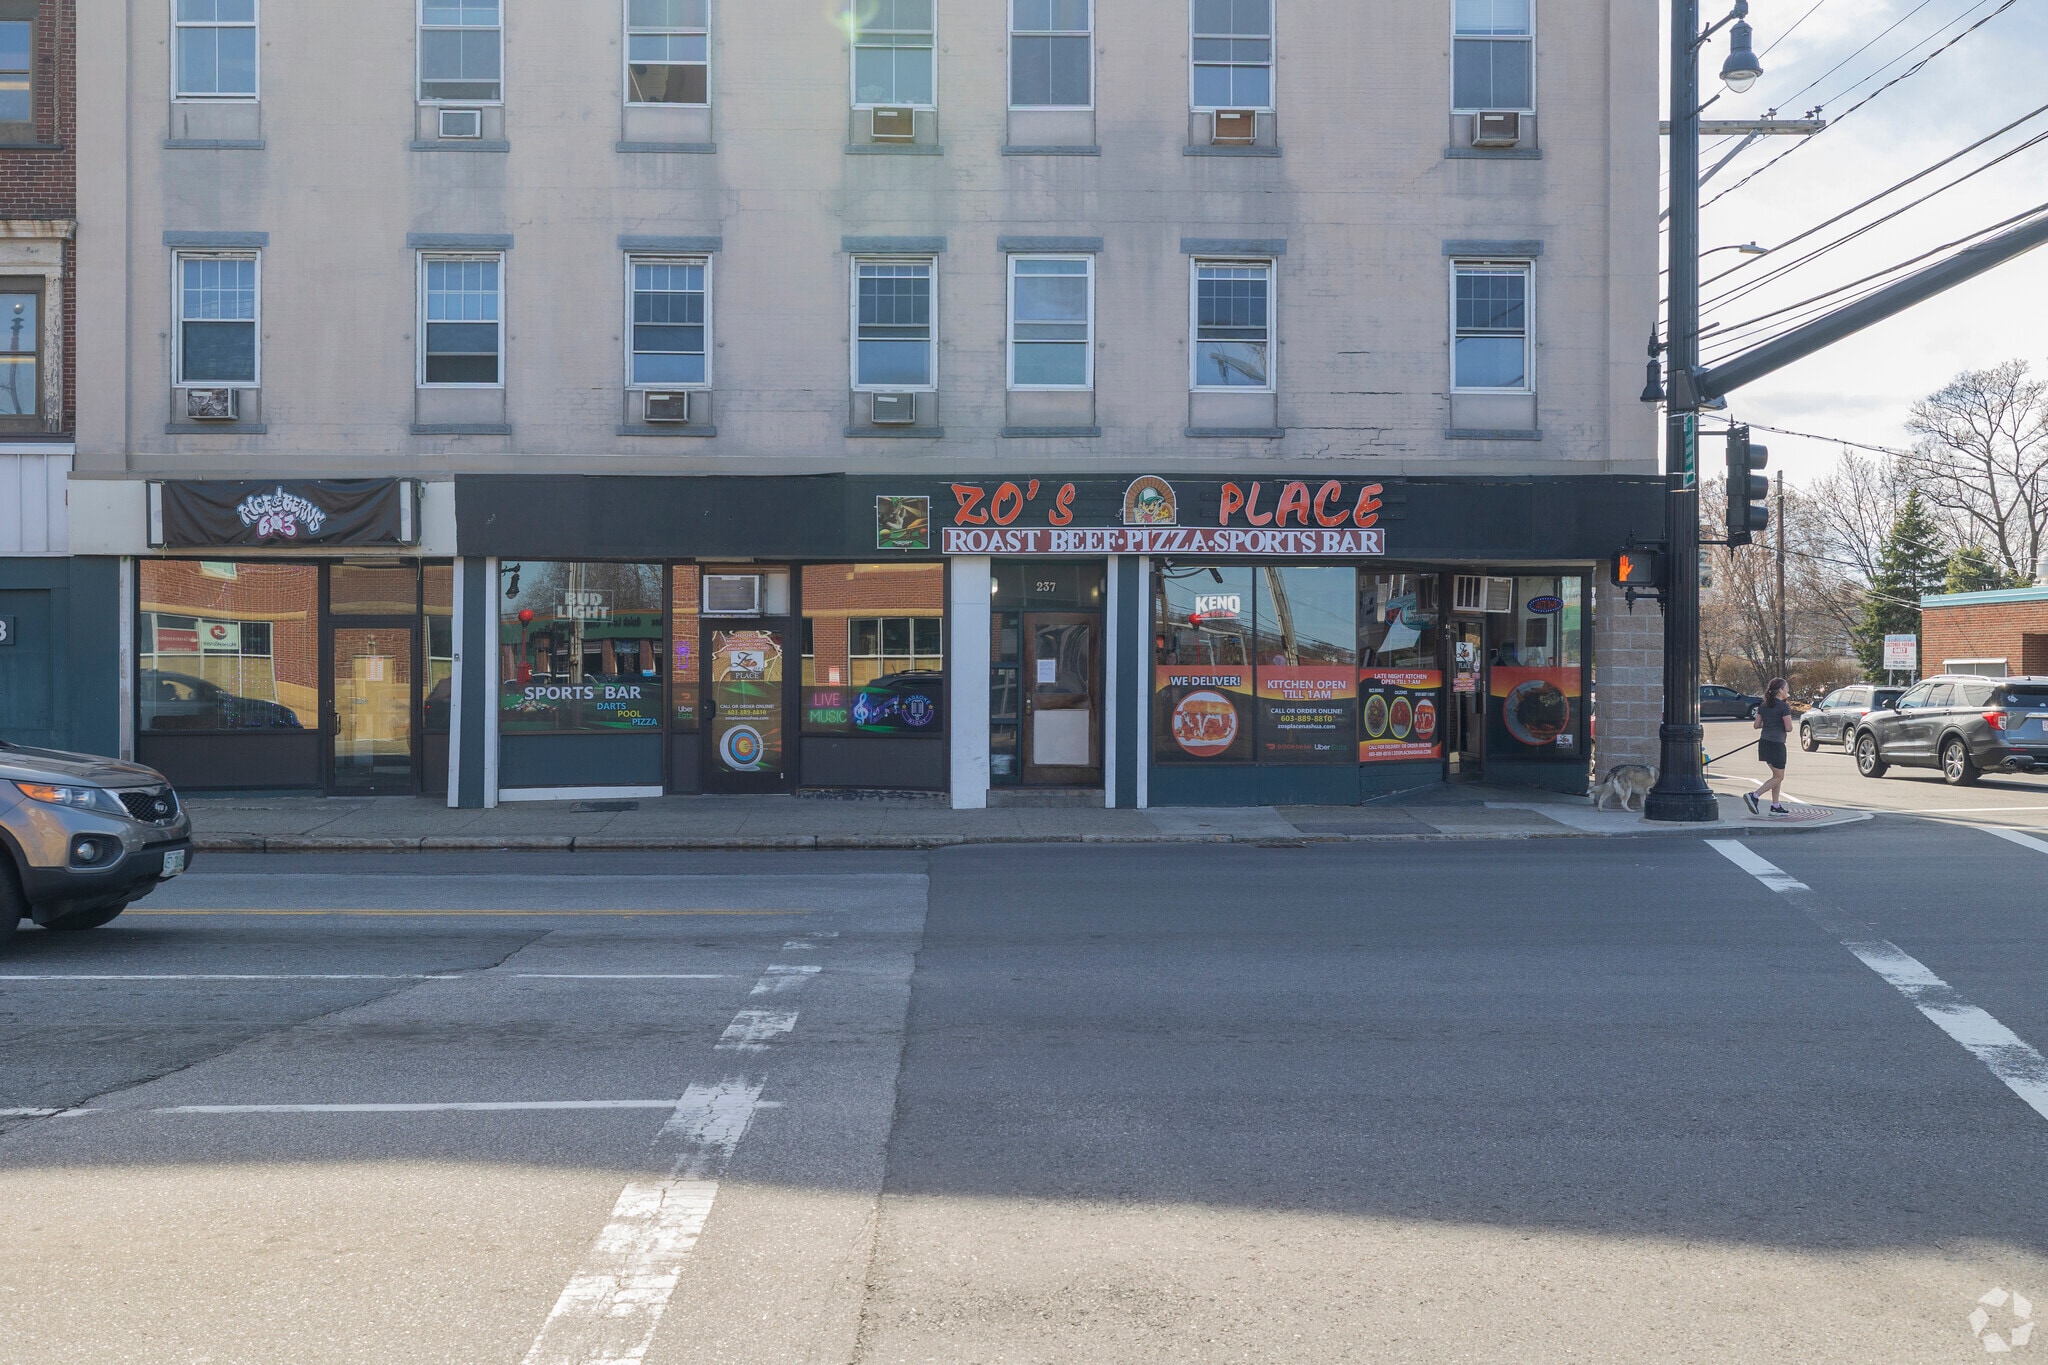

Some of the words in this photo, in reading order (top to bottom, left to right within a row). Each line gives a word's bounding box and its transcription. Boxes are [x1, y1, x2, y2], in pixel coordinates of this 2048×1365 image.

[1219, 480, 1383, 528] PLACE
[238, 495, 272, 525] RICE
[282, 493, 326, 532] BEANS
[947, 529, 1041, 552] ROAST
[1321, 531, 1381, 553] BAR
[1036, 581, 1056, 592] 237
[564, 592, 603, 606] BUD
[1195, 595, 1241, 615] KENO
[556, 605, 610, 619] LIGHT
[1170, 676, 1189, 686] WE
[1190, 676, 1242, 686] DELIVER!
[1267, 679, 1314, 689] KITCHEN
[1316, 680, 1347, 689] OPEN
[524, 685, 594, 701] SPORTS
[604, 685, 642, 700] BAR
[1282, 689, 1305, 699] TILL
[1307, 689, 1332, 699] 1AM
[814, 693, 841, 706] LIVE
[904, 694, 931, 705] KARAOKE
[596, 702, 627, 710] DARTS
[677, 705, 694, 713] Uber
[617, 709, 642, 718] POOL
[809, 709, 848, 723] MUSIC
[631, 718, 658, 726] PIZZA
[1314, 743, 1331, 751] Uber
